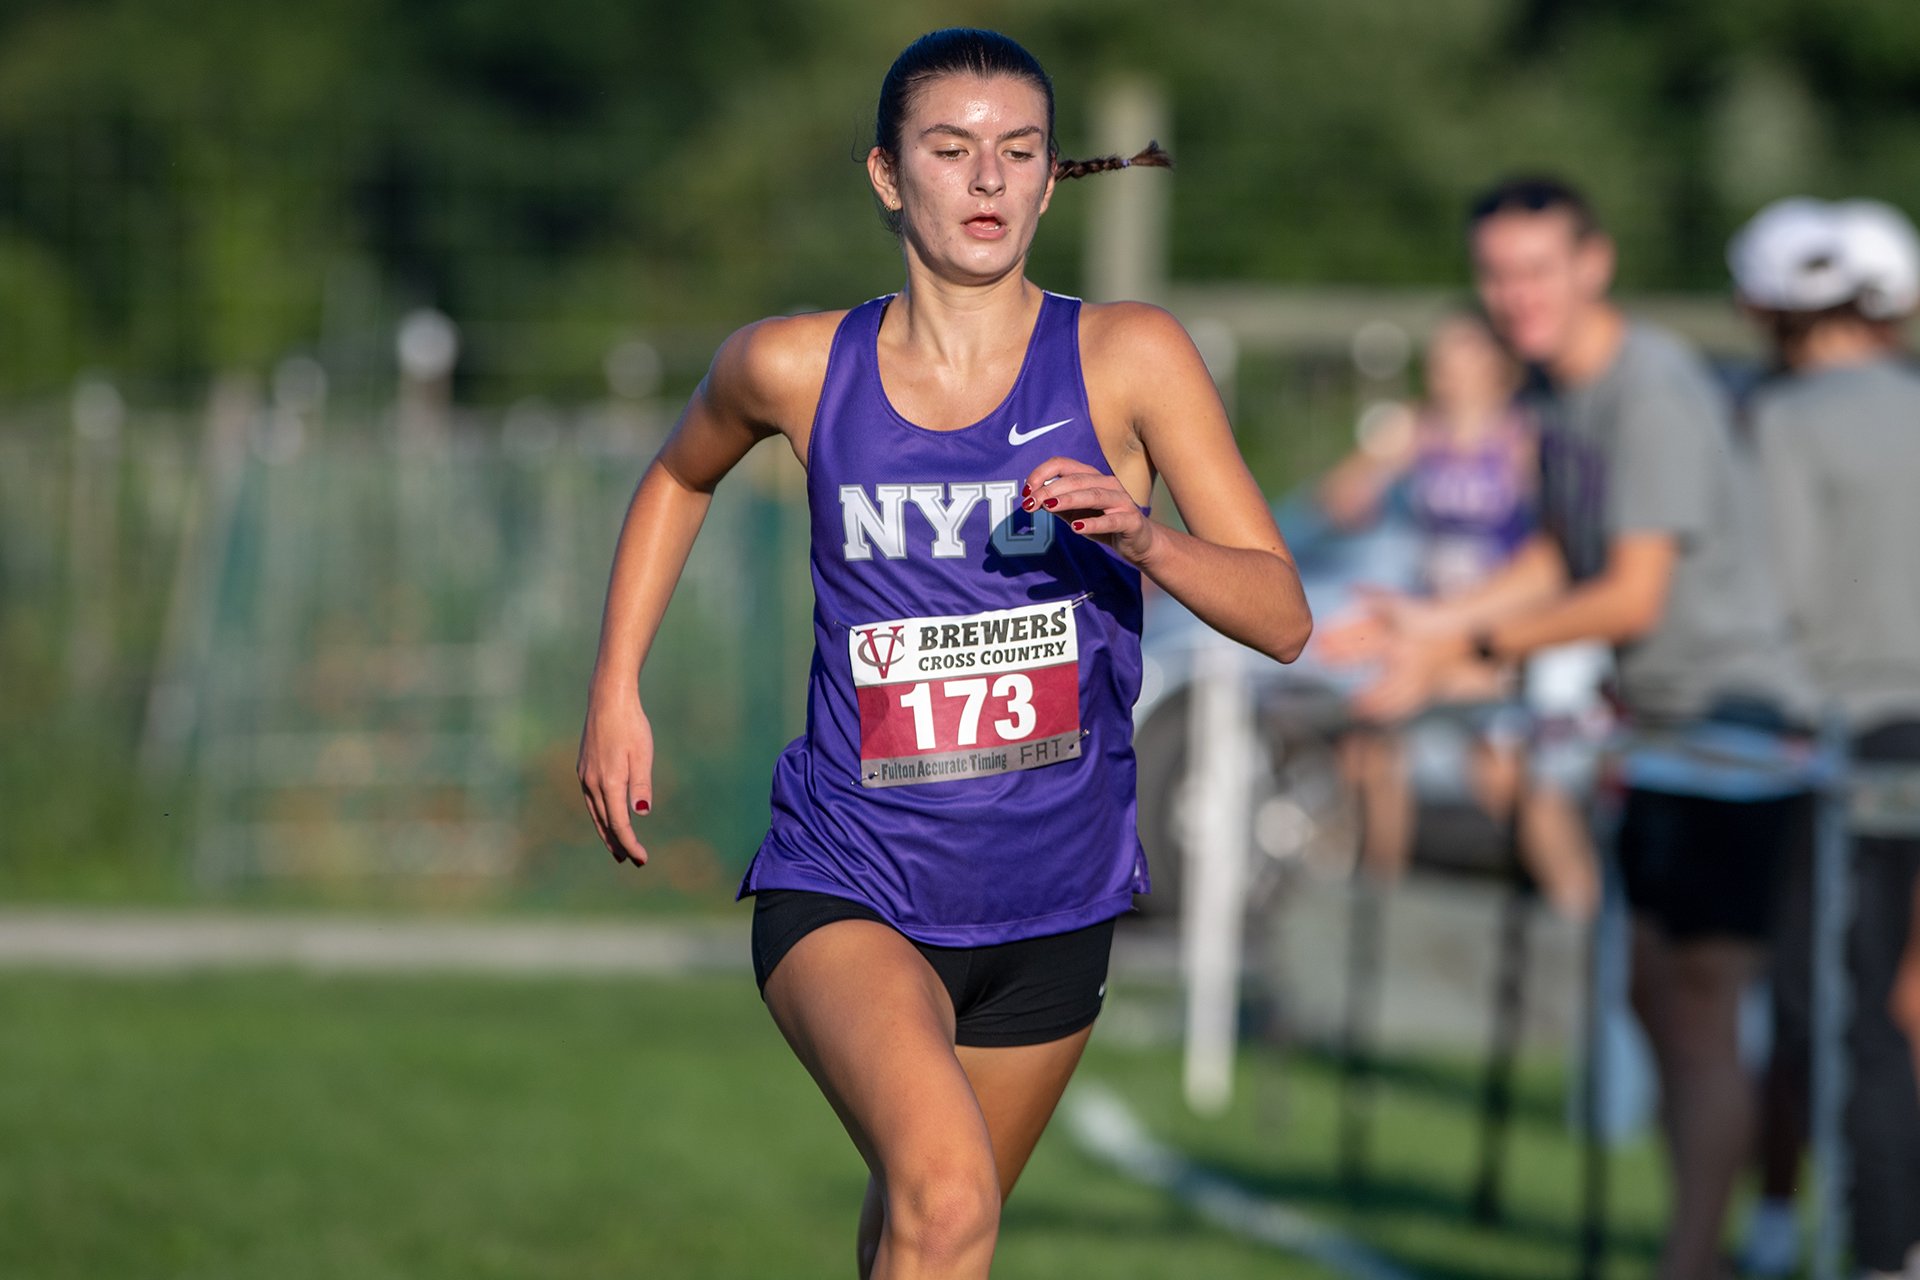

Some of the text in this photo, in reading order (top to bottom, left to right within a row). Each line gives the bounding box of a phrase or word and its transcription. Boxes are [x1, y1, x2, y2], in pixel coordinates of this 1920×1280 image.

[839, 480, 1057, 562] NYU
[918, 611, 1067, 651] BREWERS
[918, 640, 1067, 672] CROSS COUNTRY
[900, 673, 1037, 750] 173
[881, 752, 1007, 781] Fulton Accurate Timing
[1020, 738, 1062, 765] FAT
